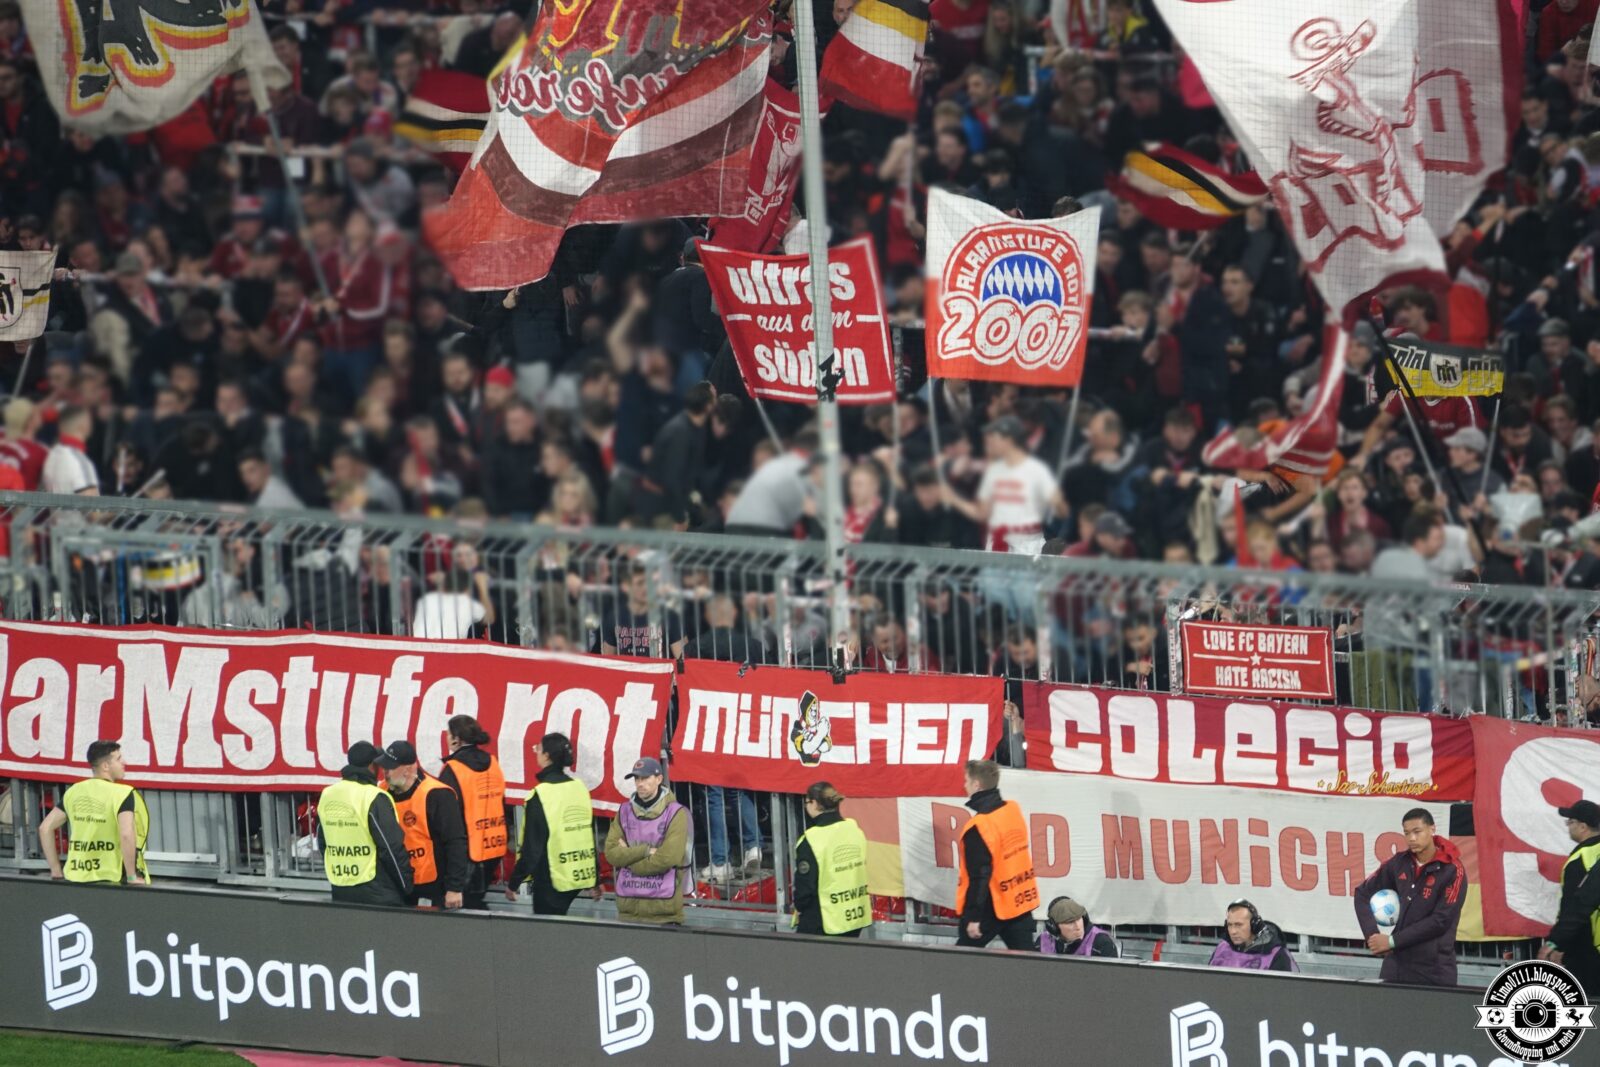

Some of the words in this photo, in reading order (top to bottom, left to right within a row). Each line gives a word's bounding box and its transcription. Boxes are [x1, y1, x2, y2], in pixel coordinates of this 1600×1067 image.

[956, 234, 1068, 291] ALARMSTUFE
[1063, 262, 1079, 305] ROT
[757, 312, 794, 332] aus
[801, 310, 853, 332] dm
[941, 297, 1083, 368] 2001
[1203, 630, 1235, 652] LOVE
[1239, 631, 1254, 652] FC
[1258, 633, 1309, 655] BAYERN
[1215, 666, 1249, 688] HATE
[1252, 668, 1302, 690] RACISM
[0, 633, 479, 779] arMstufe
[498, 682, 658, 799] rot
[69, 841, 115, 852] TEWARD
[328, 845, 371, 857] TEWARD
[931, 802, 1071, 878] RD
[70, 858, 101, 872] 1403
[845, 905, 865, 921] 910
[126, 930, 420, 1021] bitpanda
[683, 974, 988, 1066] bitpanda
